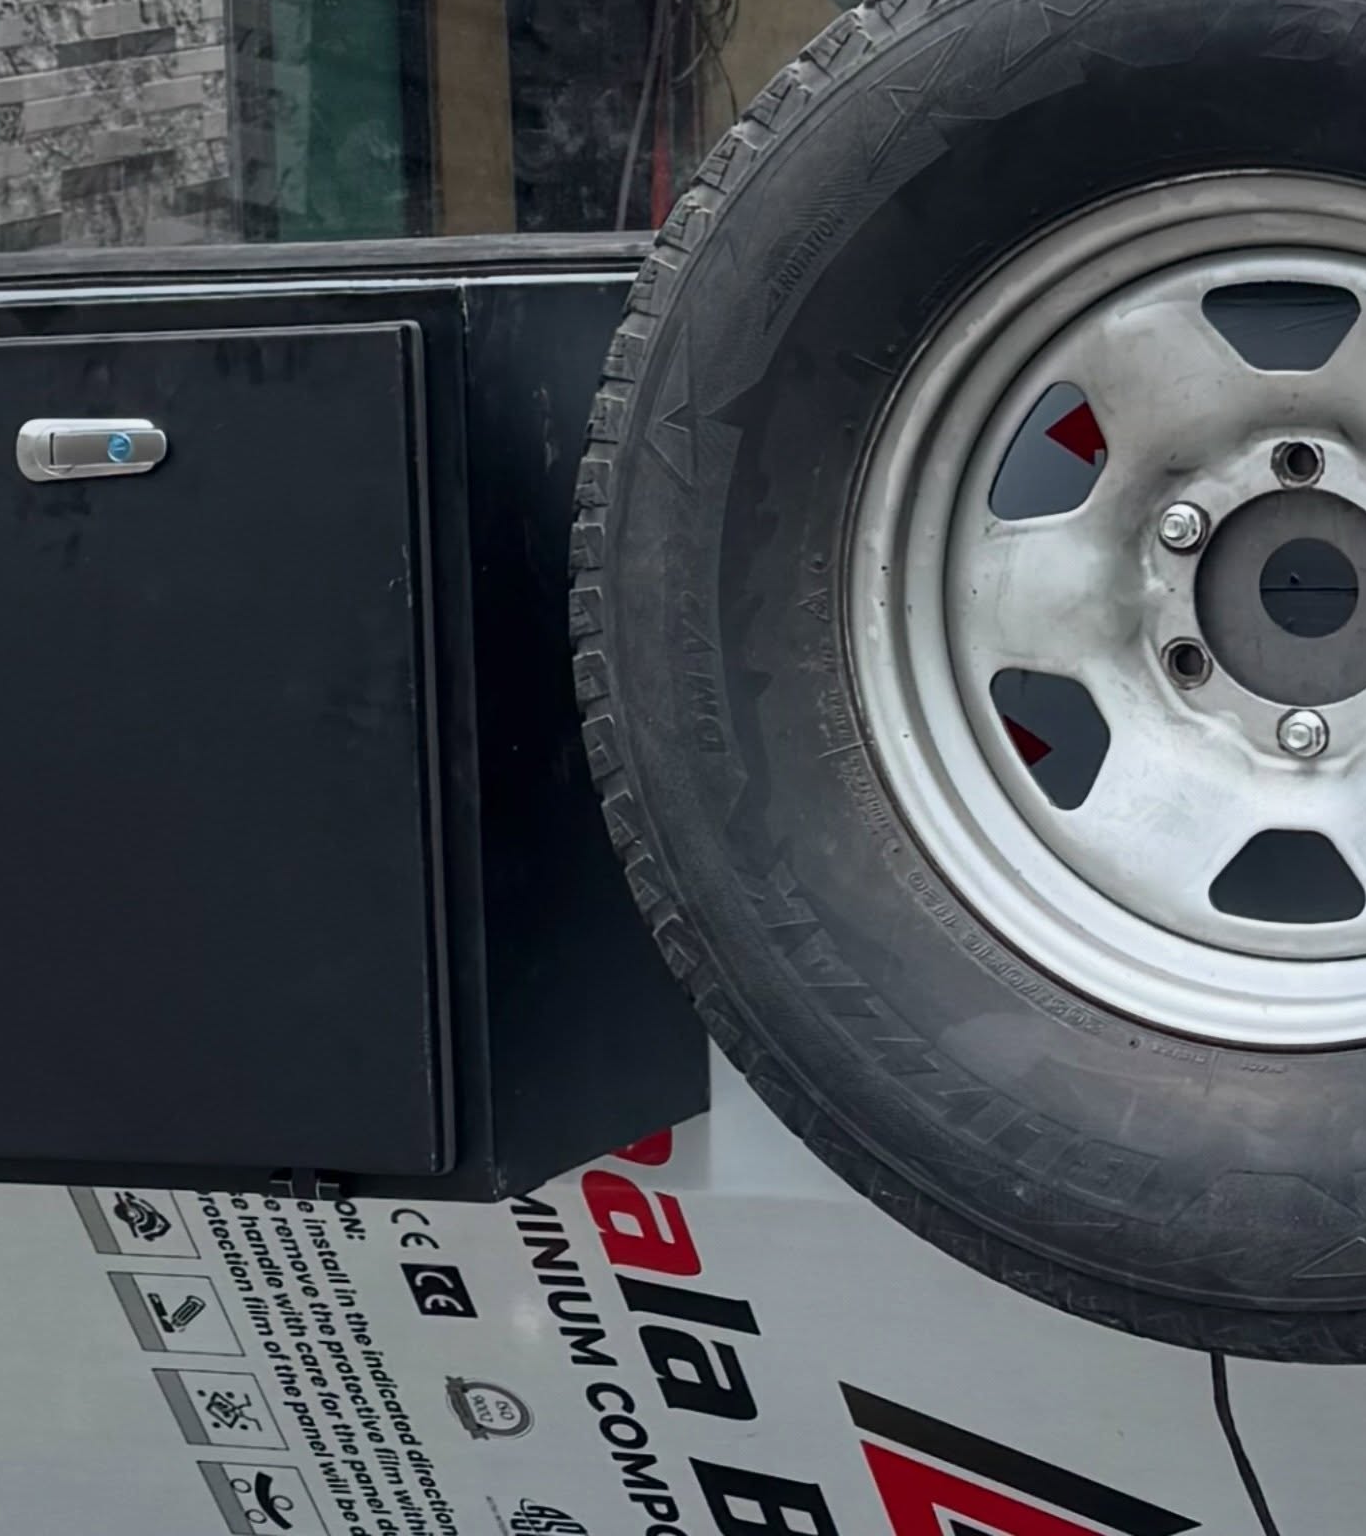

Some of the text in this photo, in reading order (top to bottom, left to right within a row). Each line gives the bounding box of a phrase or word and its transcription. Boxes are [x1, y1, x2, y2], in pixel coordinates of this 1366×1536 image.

[197, 1193, 254, 1291] rotection
[391, 1207, 440, 1250] CE
[238, 1212, 284, 1290] handle
[271, 1215, 319, 1301] remove
[414, 1271, 465, 1313] CE
[510, 1194, 618, 1367] MINIUM
[581, 1128, 761, 1420] ala
[243, 1296, 274, 1337] film
[276, 1292, 306, 1337] with
[303, 1218, 352, 1284] install
[335, 1289, 355, 1308] in
[345, 1312, 372, 1346] the
[361, 1350, 422, 1447] indicated
[309, 1304, 336, 1337] the
[264, 1340, 293, 1366] of
[295, 1340, 329, 1387] care
[274, 1362, 302, 1396] the
[317, 1339, 384, 1444] protective
[317, 1390, 344, 1419] for
[284, 1398, 335, 1458] panel
[331, 1424, 359, 1456] the
[319, 1462, 352, 1494] will
[341, 1459, 392, 1515] panel
[373, 1448, 403, 1485] film
[336, 1498, 360, 1523] be
